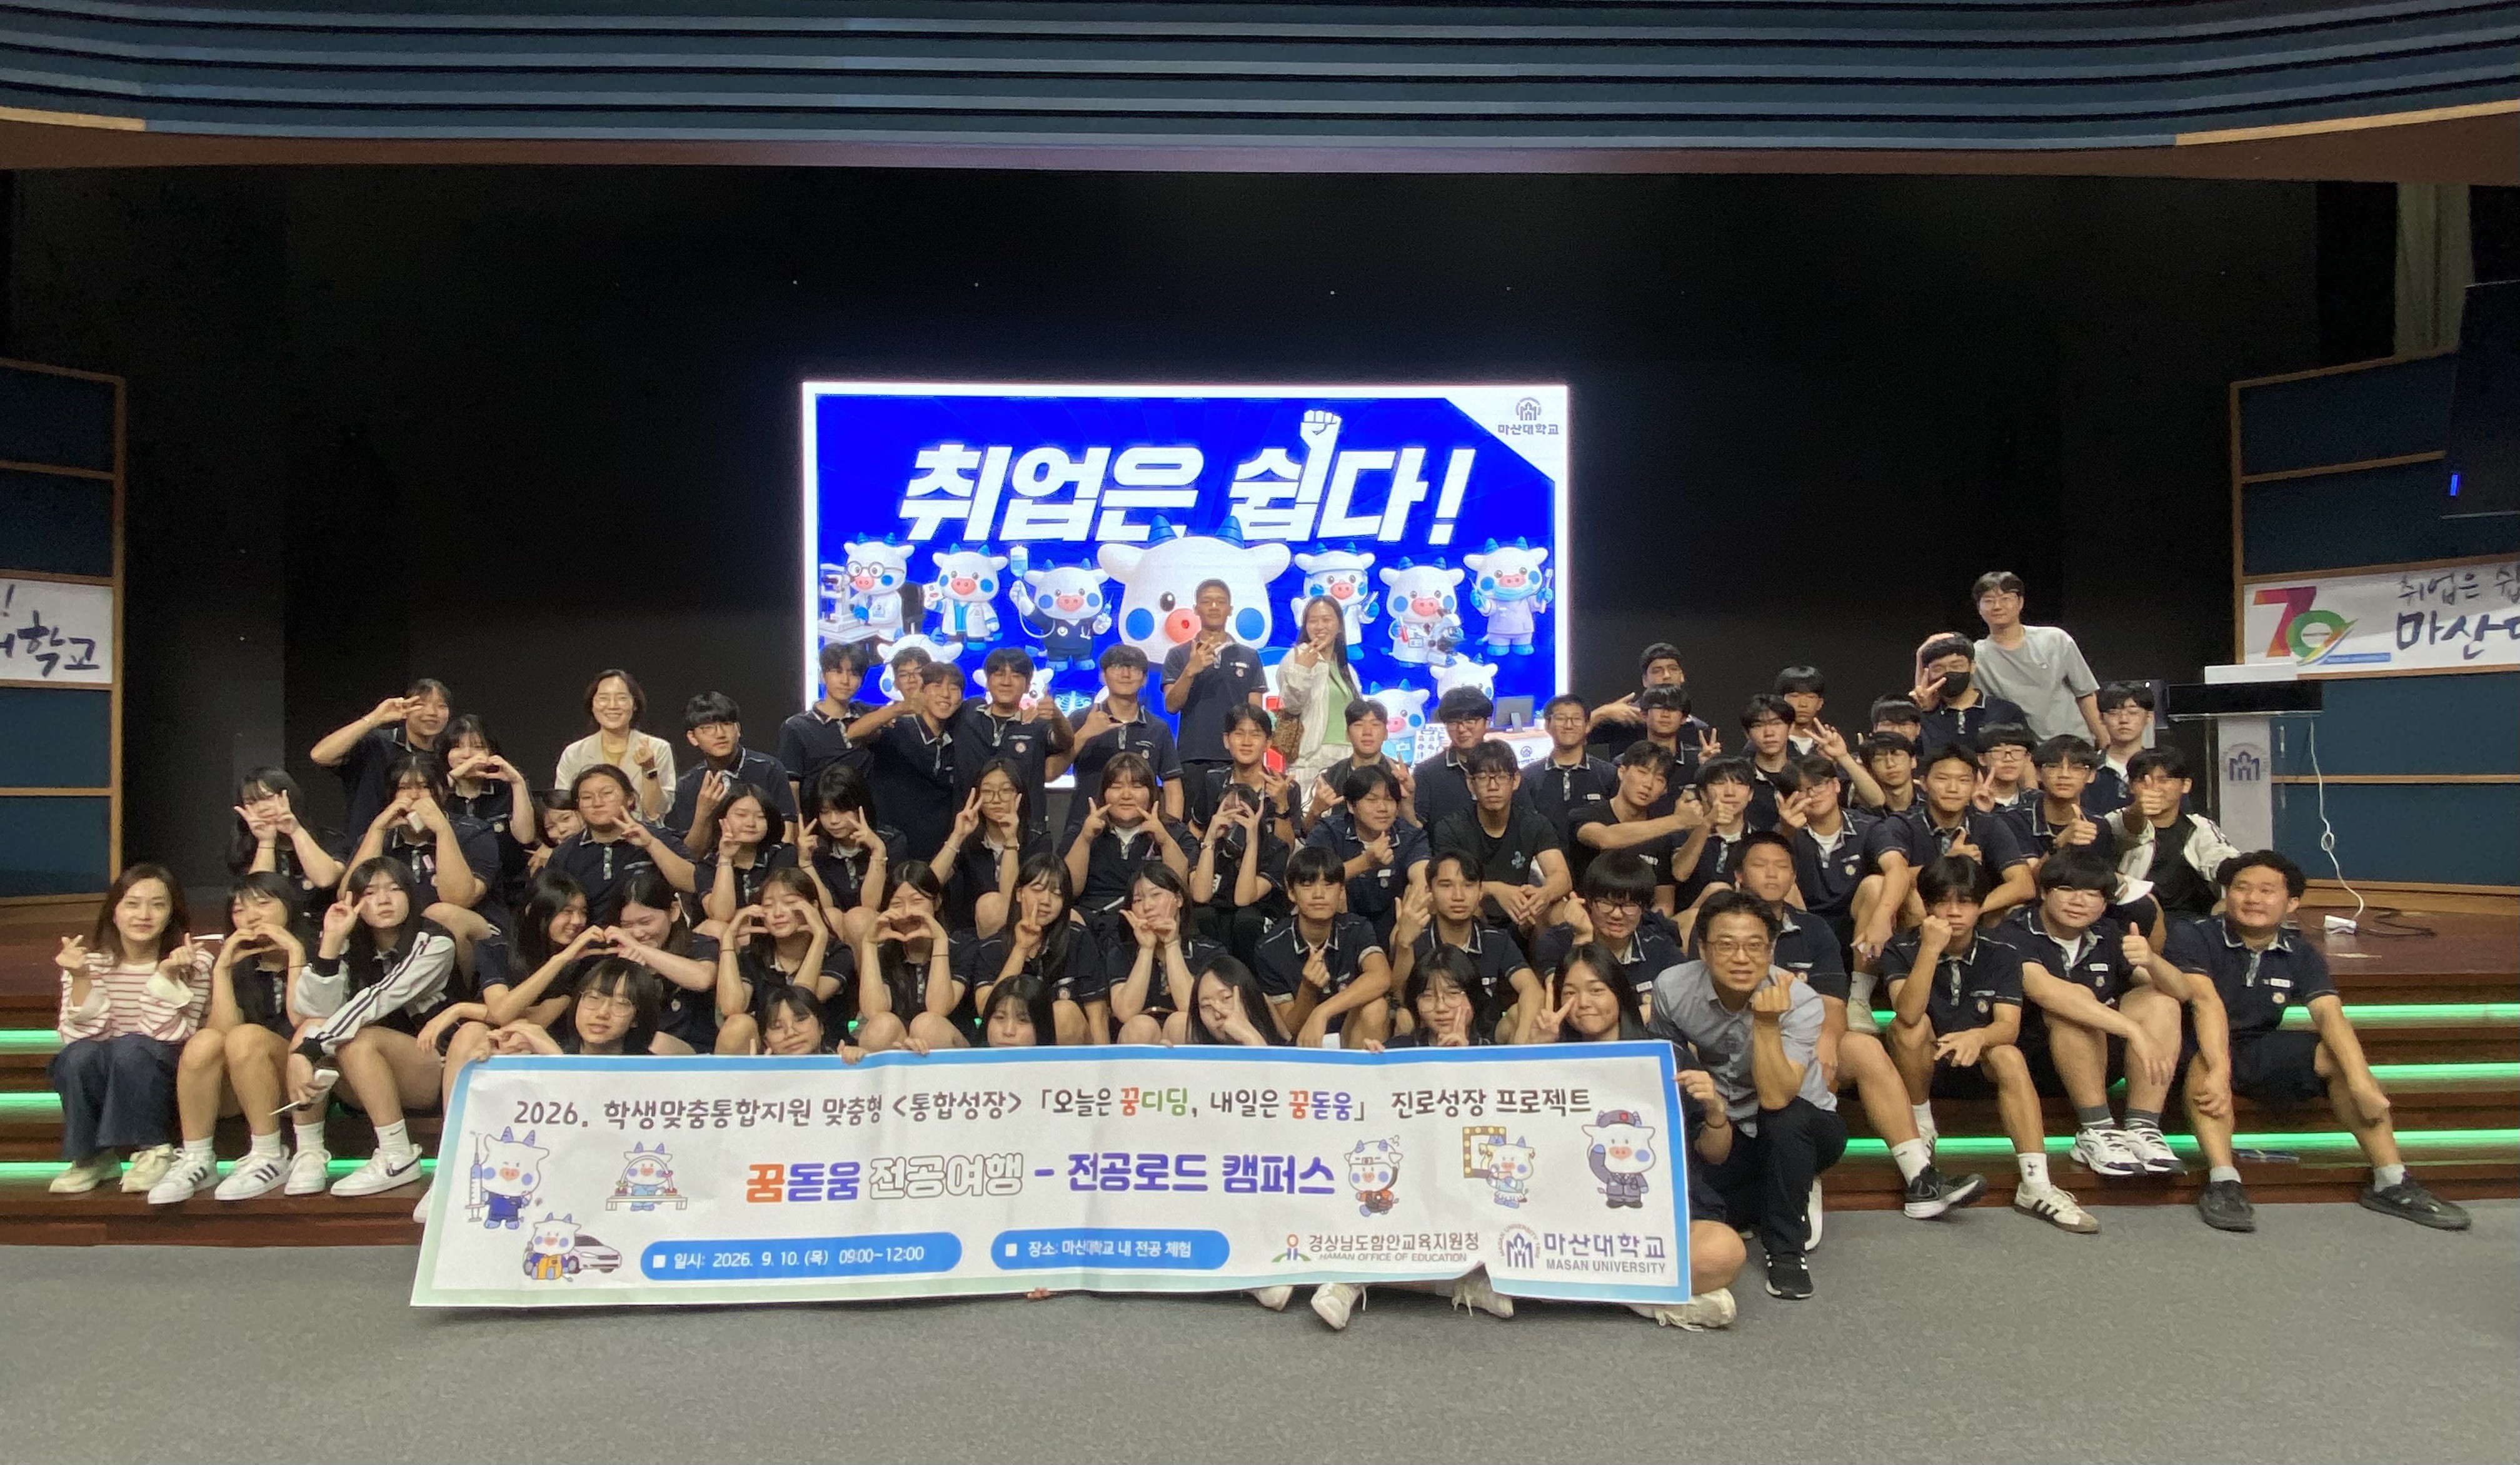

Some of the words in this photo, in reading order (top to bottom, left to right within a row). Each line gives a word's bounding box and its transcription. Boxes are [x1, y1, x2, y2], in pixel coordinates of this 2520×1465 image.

[1497, 423, 1559, 435] 마산대학교
[898, 444, 1205, 541] 취업은
[1228, 410, 1476, 545] 쉽다!
[2397, 571, 2480, 606] 취업은
[513, 1100, 588, 1127] 2026.
[604, 1099, 811, 1130] 학생맞춤통합지원
[823, 1094, 882, 1126] 맞춤형
[1210, 1089, 1279, 1119] 내일은
[1392, 1089, 1487, 1118] 진로성장
[1496, 1089, 1592, 1117] 프로젝트
[746, 1161, 860, 1204] 꿈돋움
[869, 1152, 1023, 1200] 전공여행
[1068, 1152, 1208, 1192] 전공로드
[1222, 1154, 1335, 1194] 캠퍼스
[1118, 1241, 1132, 1257] 내
[1135, 1241, 1162, 1257] 전공
[1164, 1241, 1191, 1258] 체험
[1309, 1232, 1479, 1252] 경상남도함안교육지원청
[1544, 1232, 1666, 1259] 마산대학교
[674, 1252, 706, 1269] 일시:
[713, 1252, 753, 1267] 2026.
[1319, 1252, 1355, 1261] HAMAN
[1357, 1253, 1392, 1261] OFFICE
[1395, 1252, 1408, 1261] OF
[1412, 1253, 1467, 1262] EDUCATION
[1546, 1259, 1589, 1271] MASAN
[1594, 1260, 1665, 1274] UNIVERSITY
